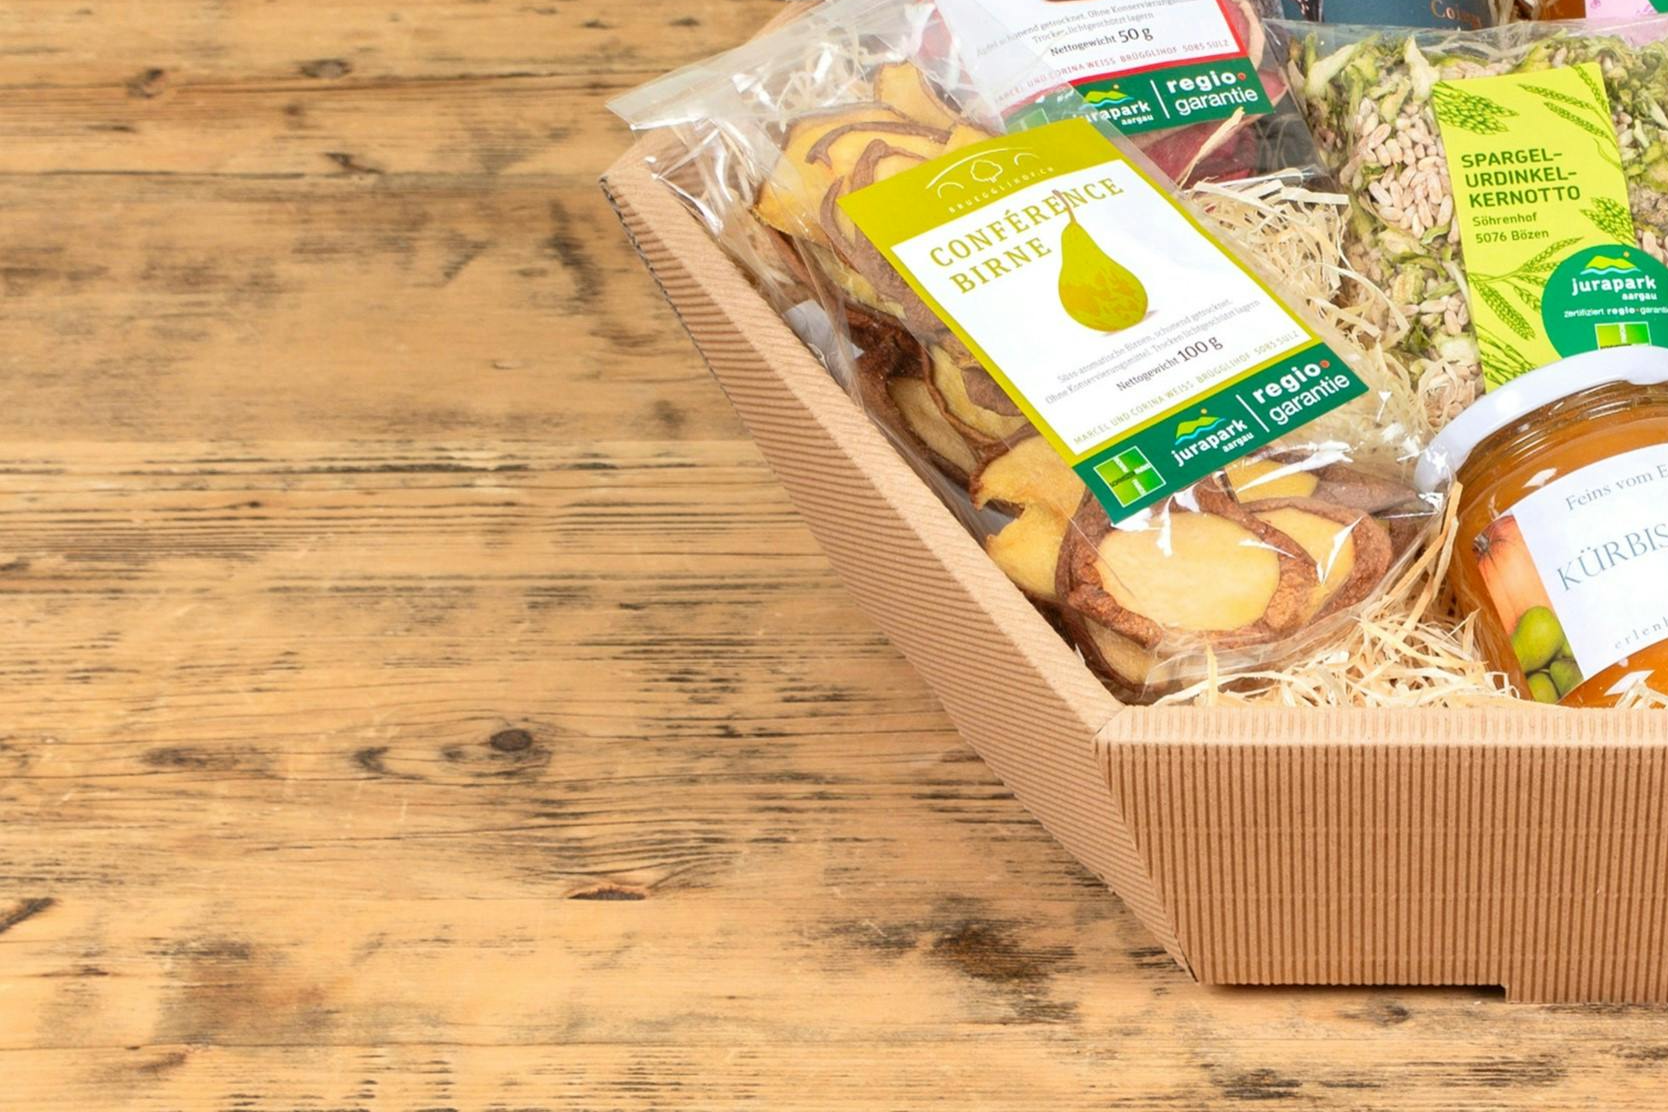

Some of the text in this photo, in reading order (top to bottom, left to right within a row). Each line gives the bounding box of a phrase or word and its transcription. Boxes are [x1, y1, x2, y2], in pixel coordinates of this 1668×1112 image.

[1088, 8, 1110, 19] Ohne
[1126, 12, 1154, 24] lagern
[1050, 27, 1154, 57] Nettogewicht 50 g
[1085, 57, 1116, 69] WEISS
[1120, 46, 1177, 63] BRÜGGLIHOF
[1206, 39, 1230, 49] SULZ
[1175, 86, 1258, 116] garantie
[1121, 114, 1154, 126] aargau
[1461, 148, 1562, 168] SPARGEL-
[1465, 166, 1577, 188] URDINKEL-
[1469, 185, 1580, 208] KERNOTTO
[929, 177, 1124, 268] CONFÉRENCE
[1472, 212, 1537, 227] Söhrenhof
[1475, 229, 1549, 244] 5076 Bözen
[949, 237, 1052, 294] BIRNE
[1571, 274, 1656, 296] jurapark
[1622, 292, 1657, 302] aargau
[1564, 308, 1604, 318] zertifiziert
[1154, 316, 1191, 338] schonend
[1045, 389, 1068, 404] Ohne
[1235, 300, 1261, 317] lagern
[1115, 336, 1223, 391] Nettogewicht 100 g
[1073, 424, 1111, 444] MARCEL
[1110, 412, 1131, 427] UND
[1130, 395, 1164, 416] CORINA
[1165, 380, 1194, 400] WEISS
[1195, 352, 1250, 384] BRÜGGLIHOF
[1276, 330, 1299, 346] SULZ
[1268, 373, 1350, 426] garantie
[1171, 416, 1248, 468] jurapark
[1221, 431, 1255, 454] aargau
[1565, 483, 1612, 511] Feins
[1616, 473, 1653, 491] vom
